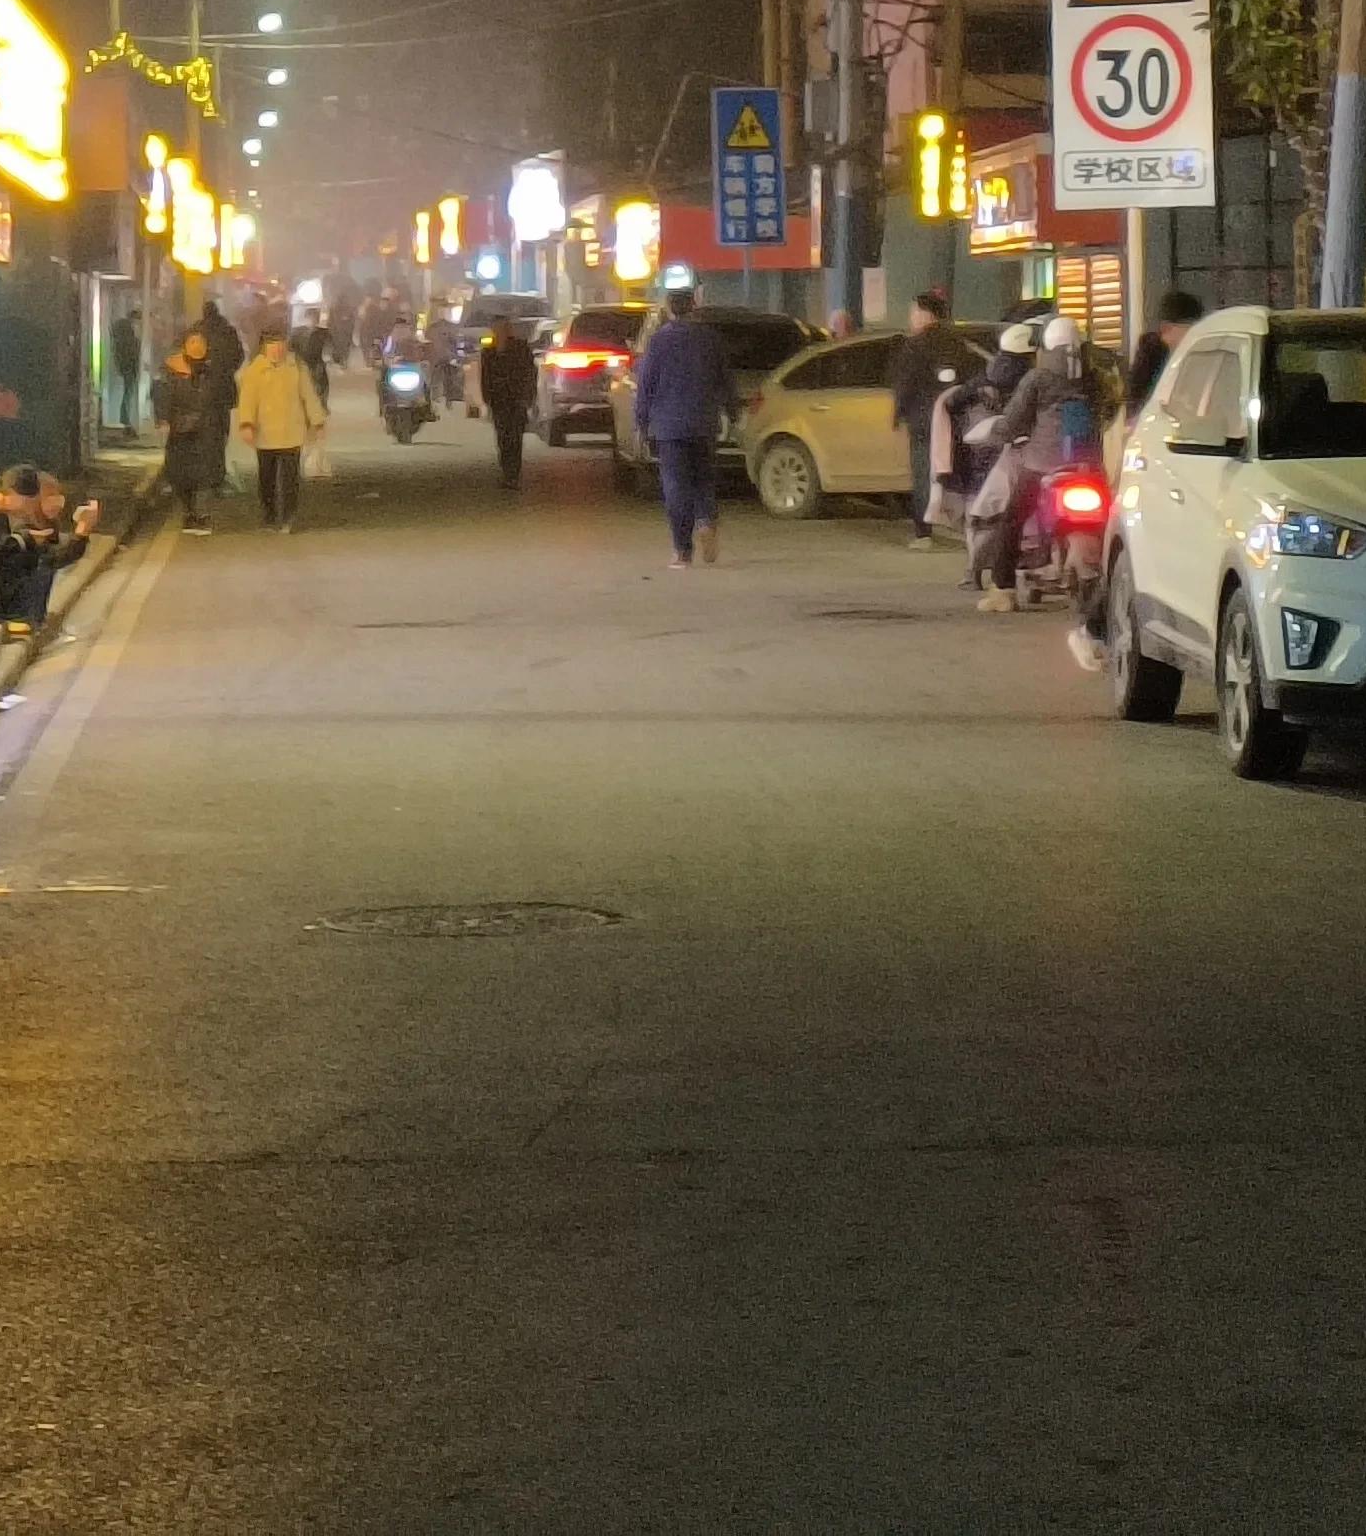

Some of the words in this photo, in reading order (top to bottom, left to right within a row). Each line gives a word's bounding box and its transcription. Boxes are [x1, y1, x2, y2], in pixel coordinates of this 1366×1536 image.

[1096, 48, 1170, 118] 30
[1073, 156, 1197, 184] 学校区域
